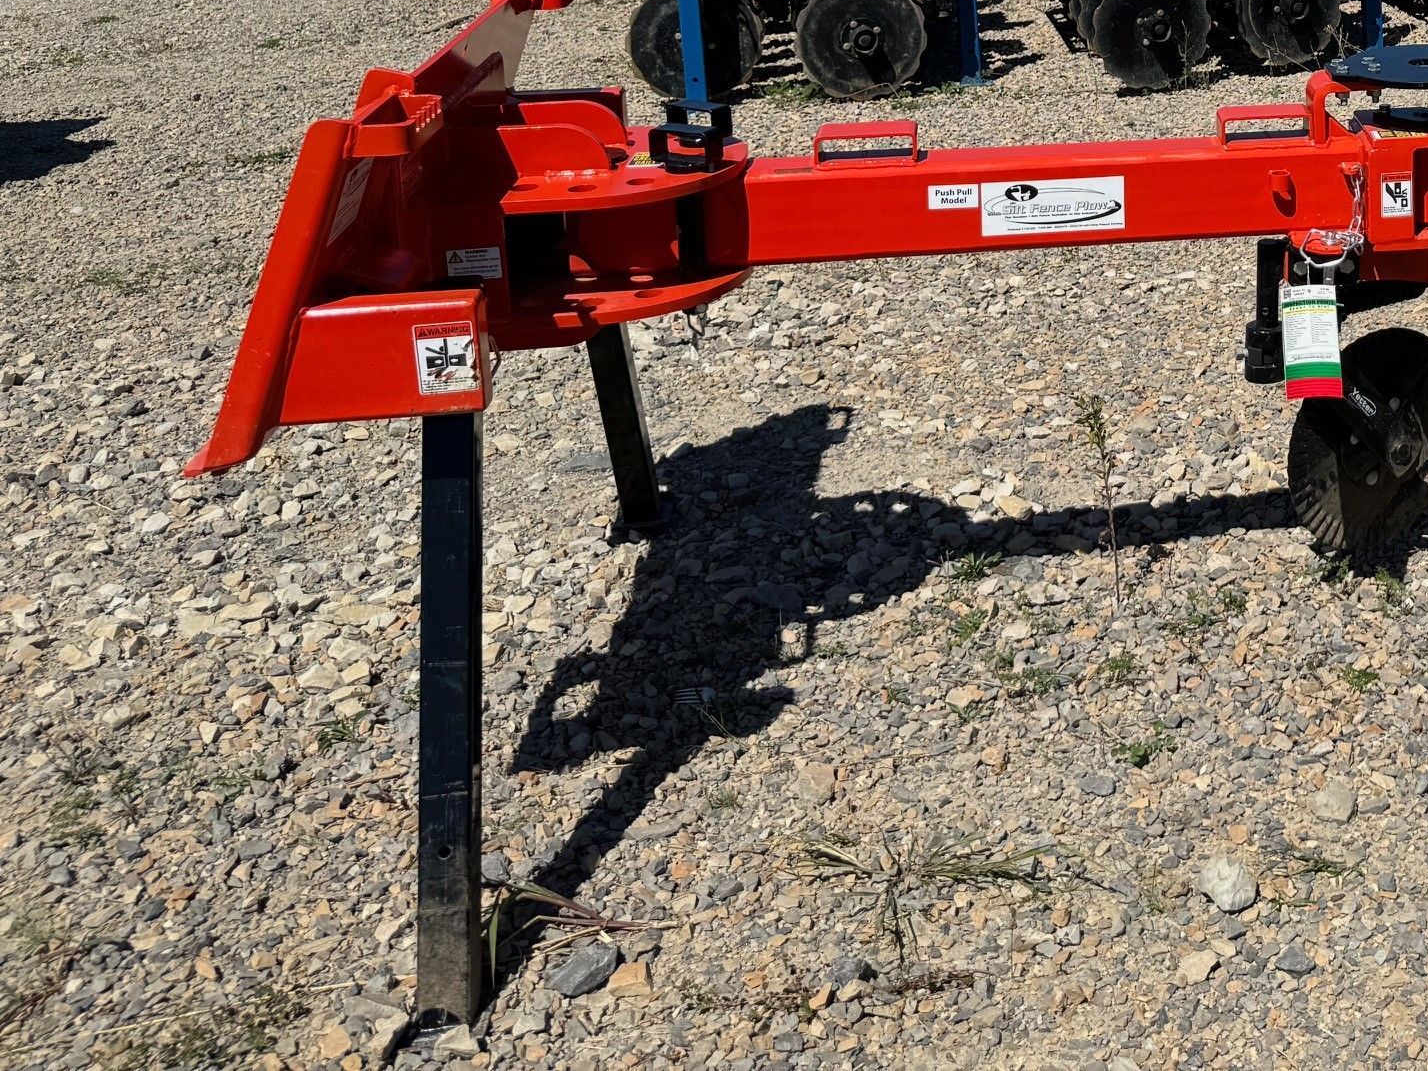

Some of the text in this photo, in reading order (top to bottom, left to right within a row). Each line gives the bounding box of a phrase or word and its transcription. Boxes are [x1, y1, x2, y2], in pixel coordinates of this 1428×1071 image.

[935, 188, 972, 197] Push Pull
[1002, 203, 1026, 215] Silt
[1030, 203, 1071, 214] Fence
[1075, 200, 1108, 212] Plow
[427, 326, 470, 336] WARNING
[1352, 386, 1374, 414] Yetter
